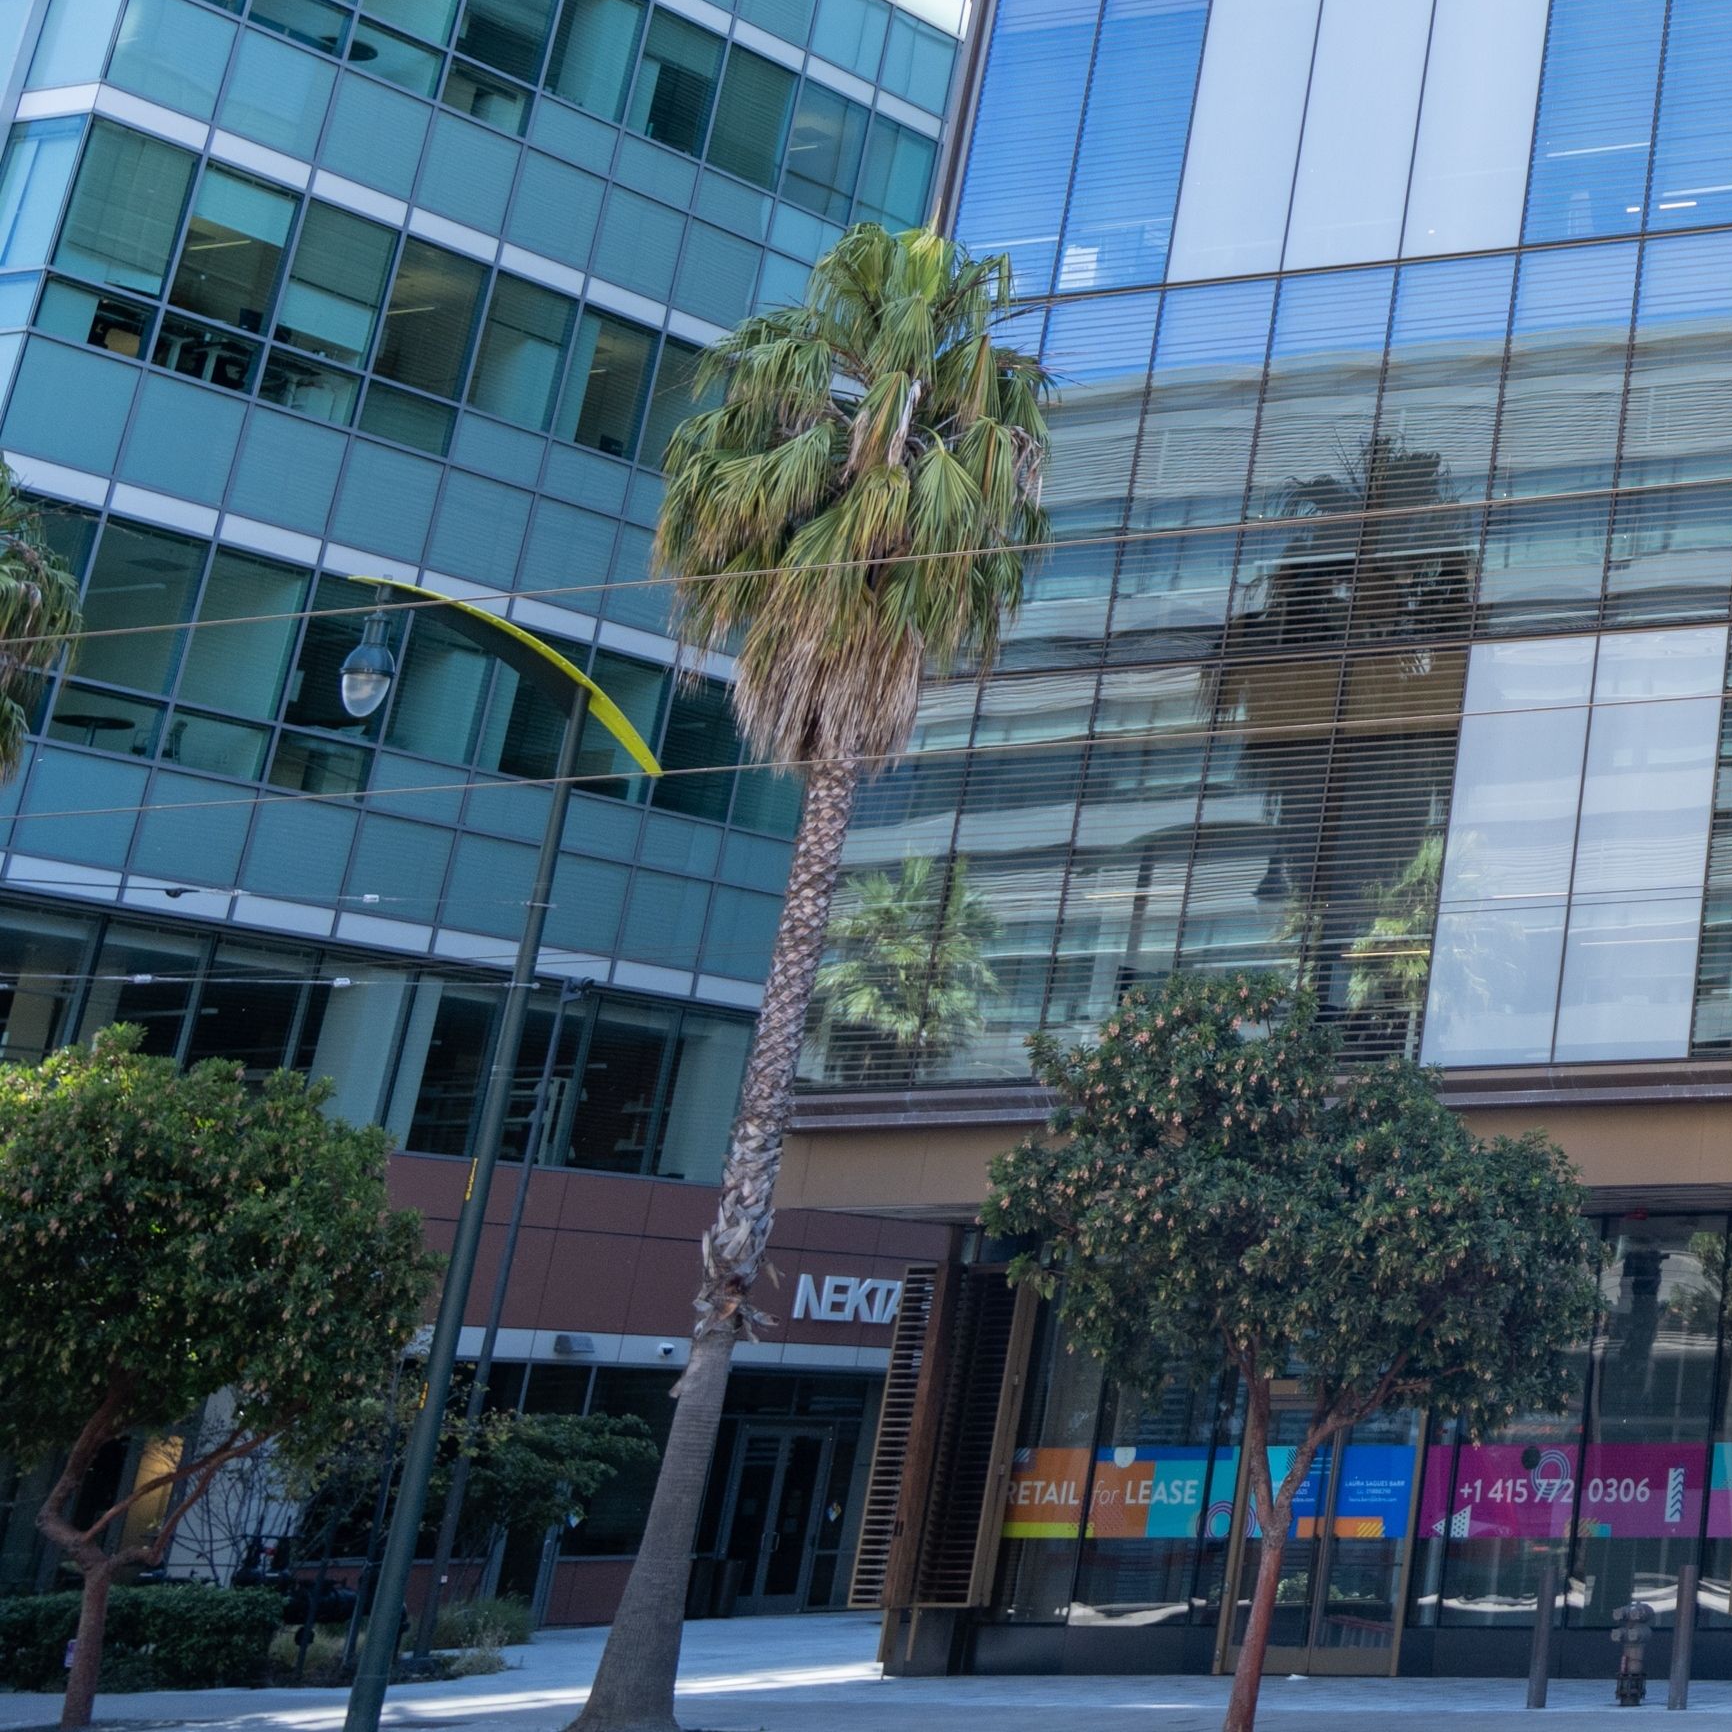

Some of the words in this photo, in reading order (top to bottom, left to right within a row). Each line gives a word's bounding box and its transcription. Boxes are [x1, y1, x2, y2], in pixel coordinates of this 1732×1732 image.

[793, 1273, 904, 1324] NEKTA
[1008, 1480, 1080, 1505] RETAIL
[1089, 1479, 1120, 1515] for
[1124, 1479, 1200, 1505] LEASE
[1459, 1478, 1482, 1504] +1
[1487, 1478, 1529, 1504] 415
[1533, 1478, 1575, 1504] 772
[1588, 1476, 1651, 1503] 0306
